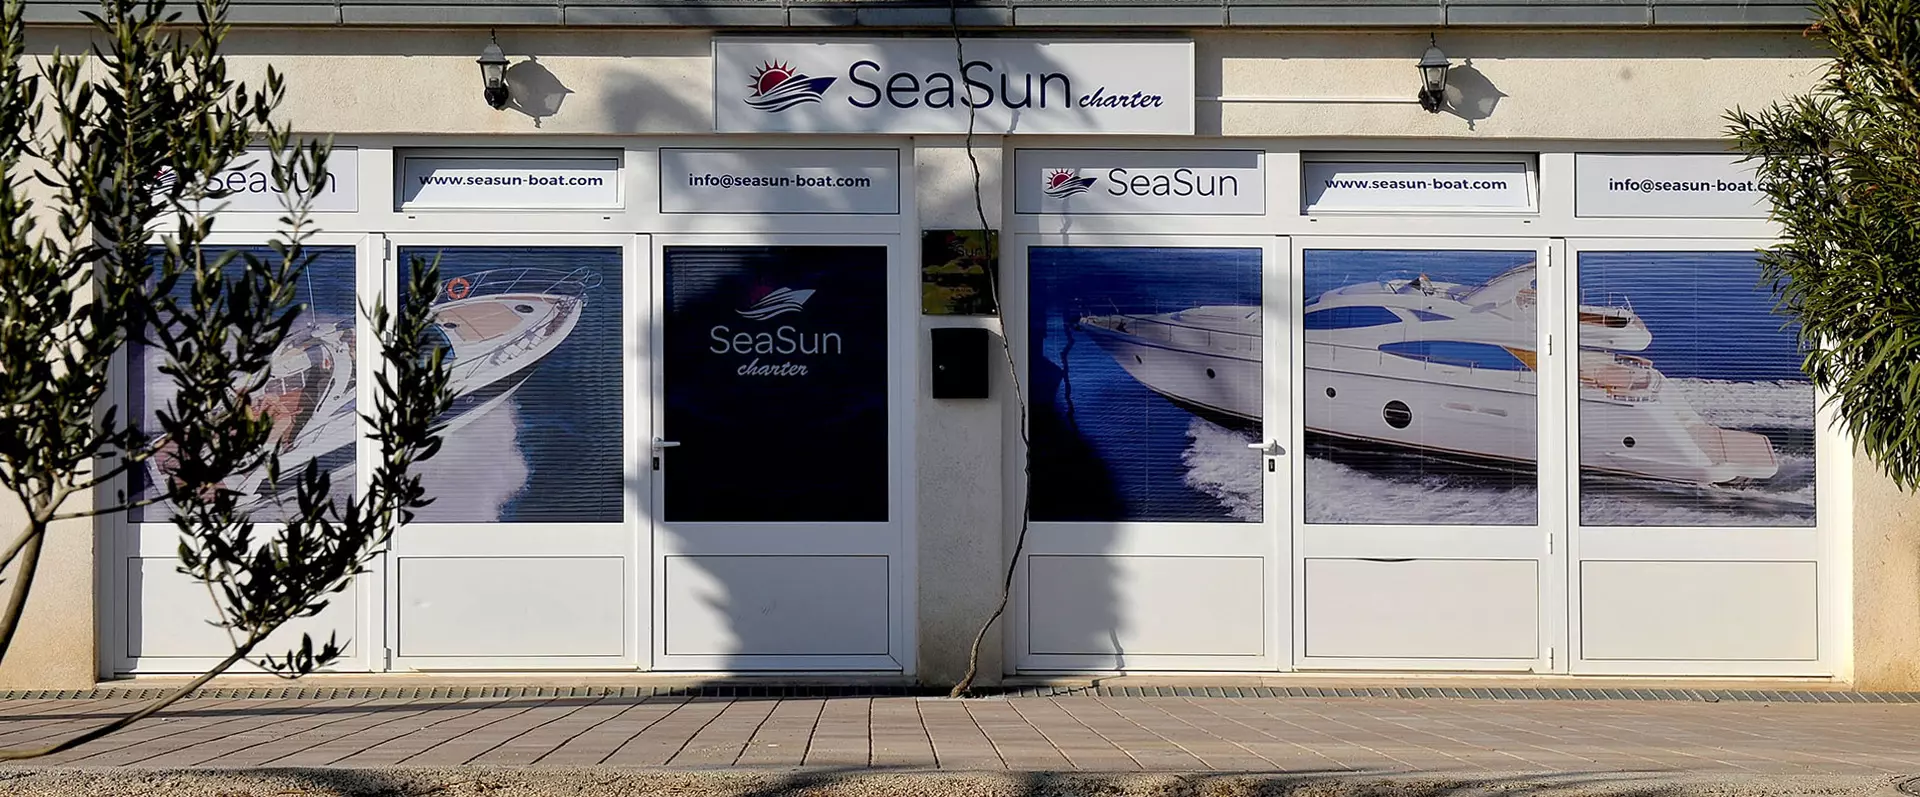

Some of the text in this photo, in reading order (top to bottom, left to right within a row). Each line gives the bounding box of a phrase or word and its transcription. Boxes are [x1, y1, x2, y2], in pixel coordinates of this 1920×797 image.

[847, 60, 1165, 109] SeaSun charter
[418, 172, 603, 187] www.seasun-boat.com
[687, 172, 871, 191] info@seasun-boat.com
[1107, 167, 1239, 197] SeaSun
[1324, 176, 1508, 192] www.seasun-boat.com
[709, 325, 842, 355] SeaSun
[736, 357, 809, 377] charter
